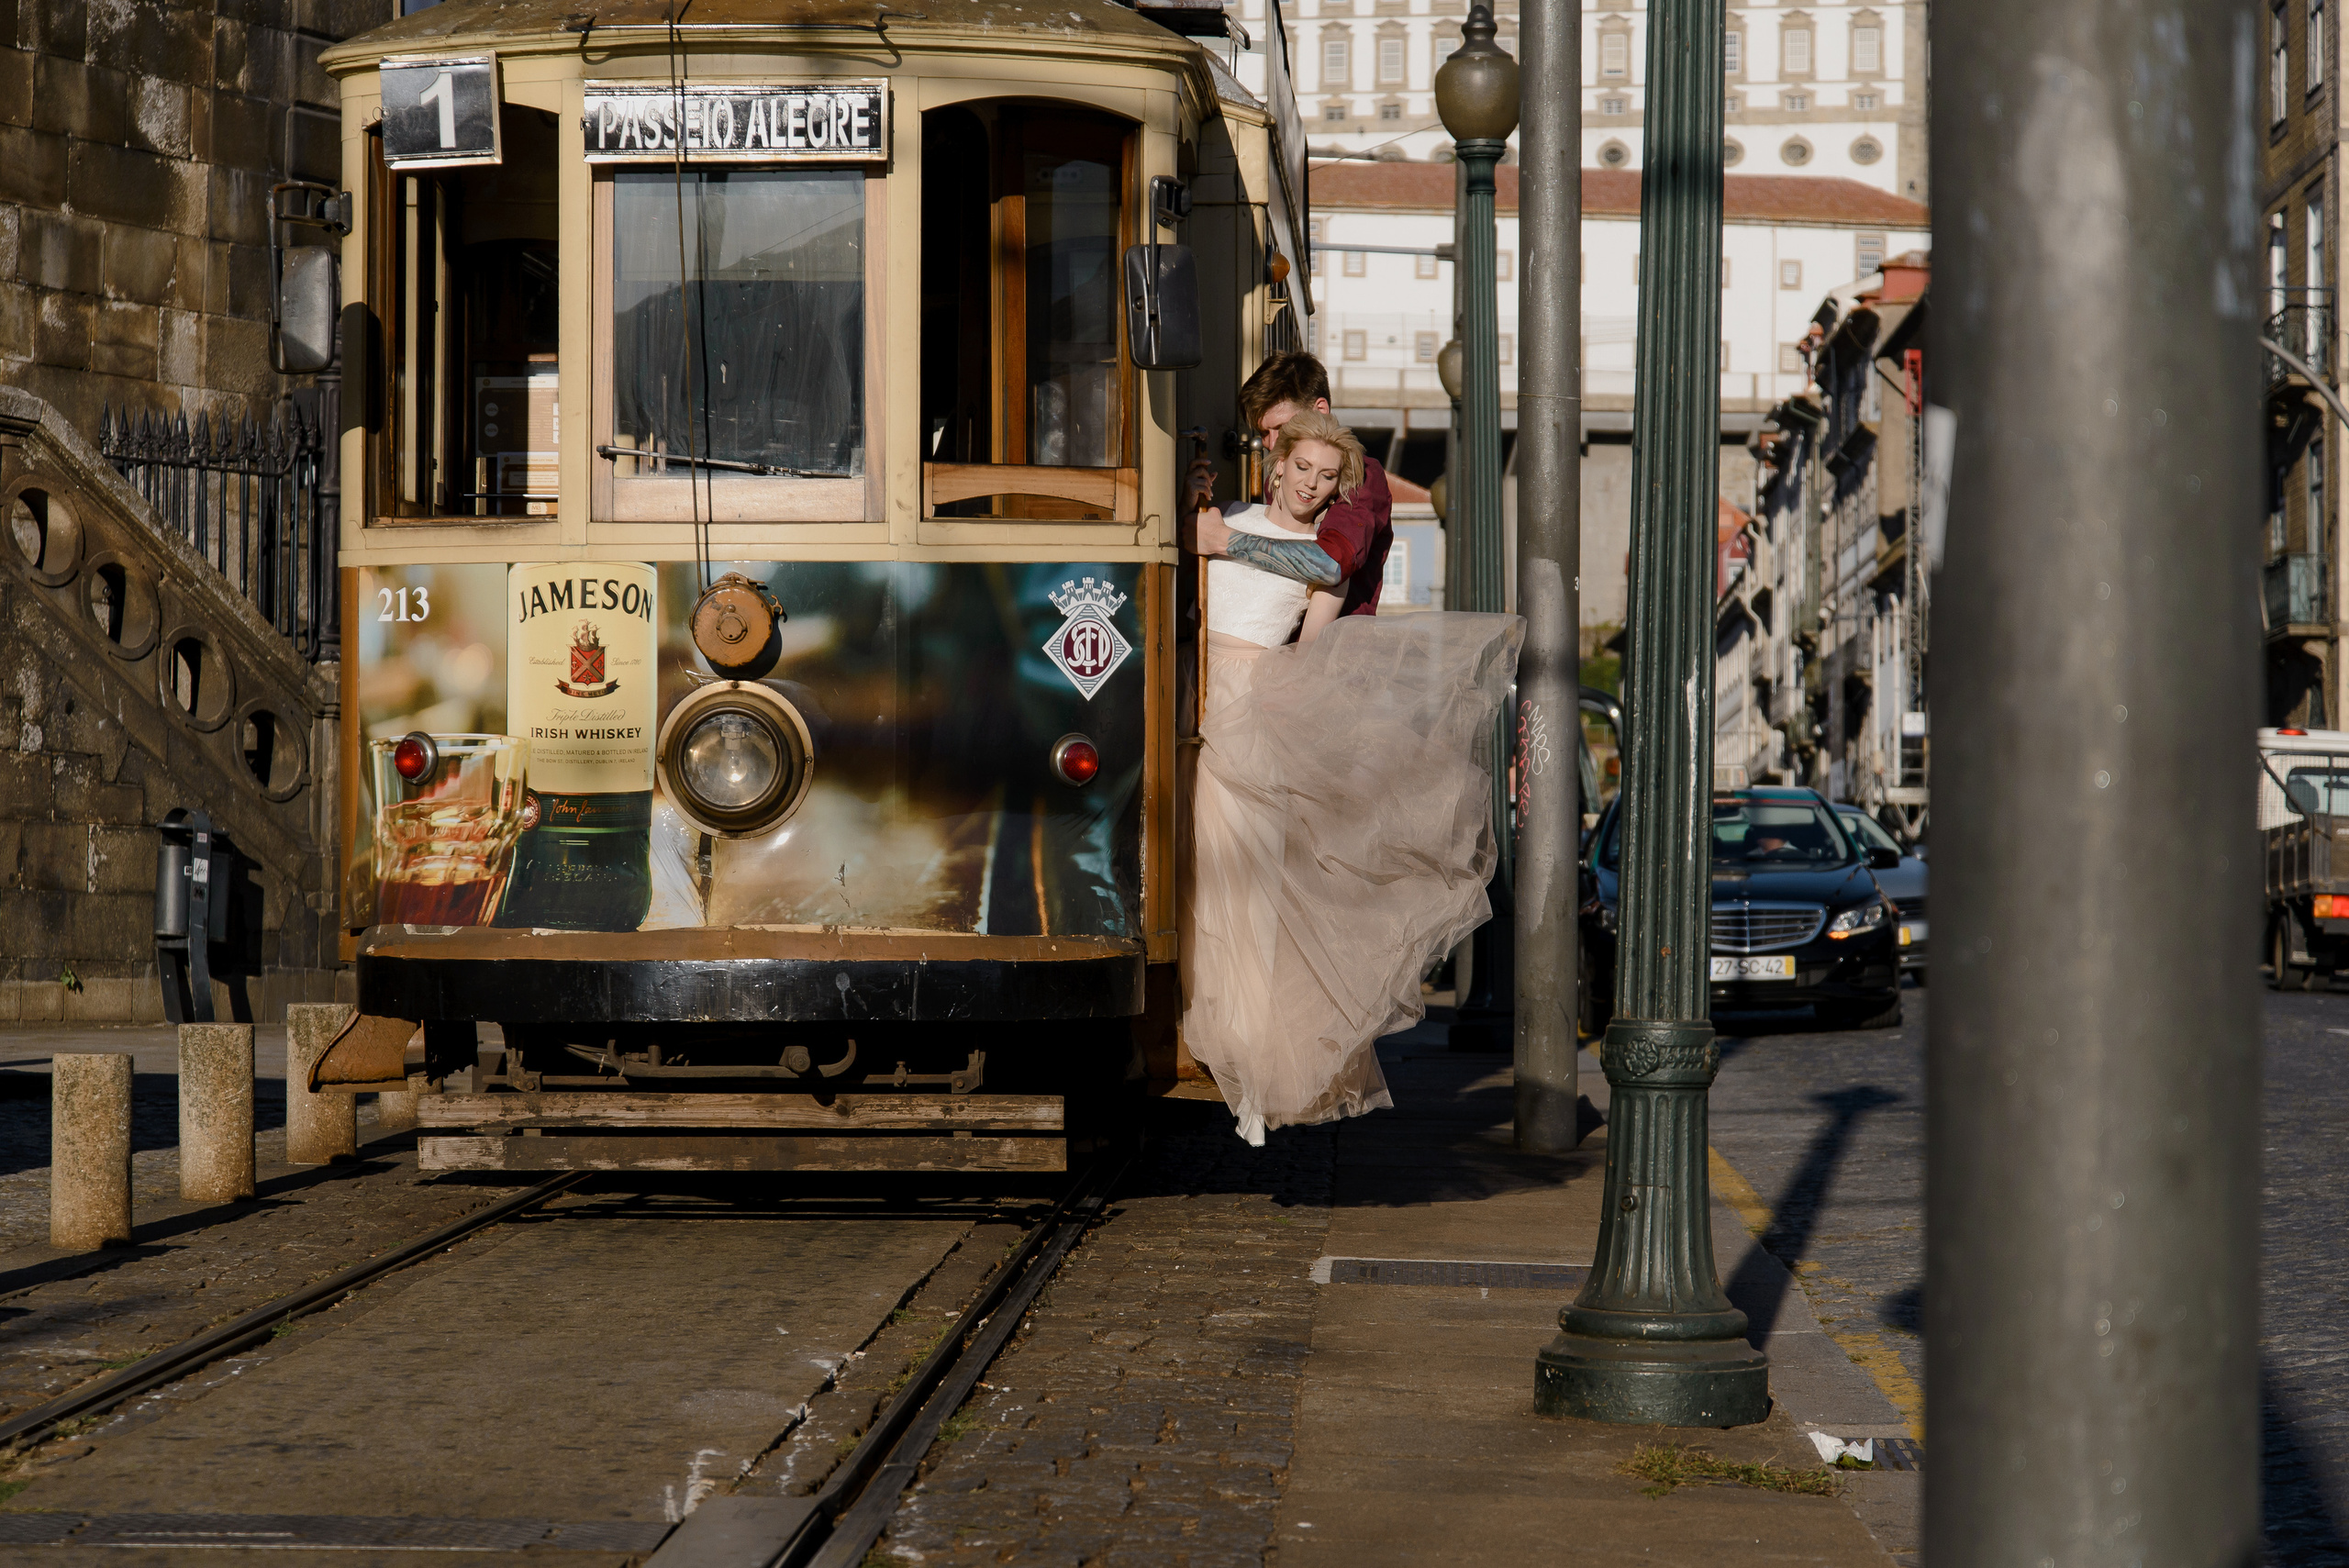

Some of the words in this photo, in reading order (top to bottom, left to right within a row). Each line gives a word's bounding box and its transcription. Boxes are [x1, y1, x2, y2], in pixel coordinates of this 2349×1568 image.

[419, 71, 456, 148] 1
[597, 98, 734, 150] PASSEIO
[745, 97, 870, 149] ALEGRE
[377, 586, 430, 622] 213
[518, 578, 653, 624] JAMESON
[529, 656, 566, 666] Established
[609, 657, 629, 665] Since
[546, 707, 579, 725] Triple
[579, 708, 626, 721] Distilled
[530, 727, 569, 739] IRISH
[574, 727, 641, 740] WHISKEY
[549, 798, 577, 822] John
